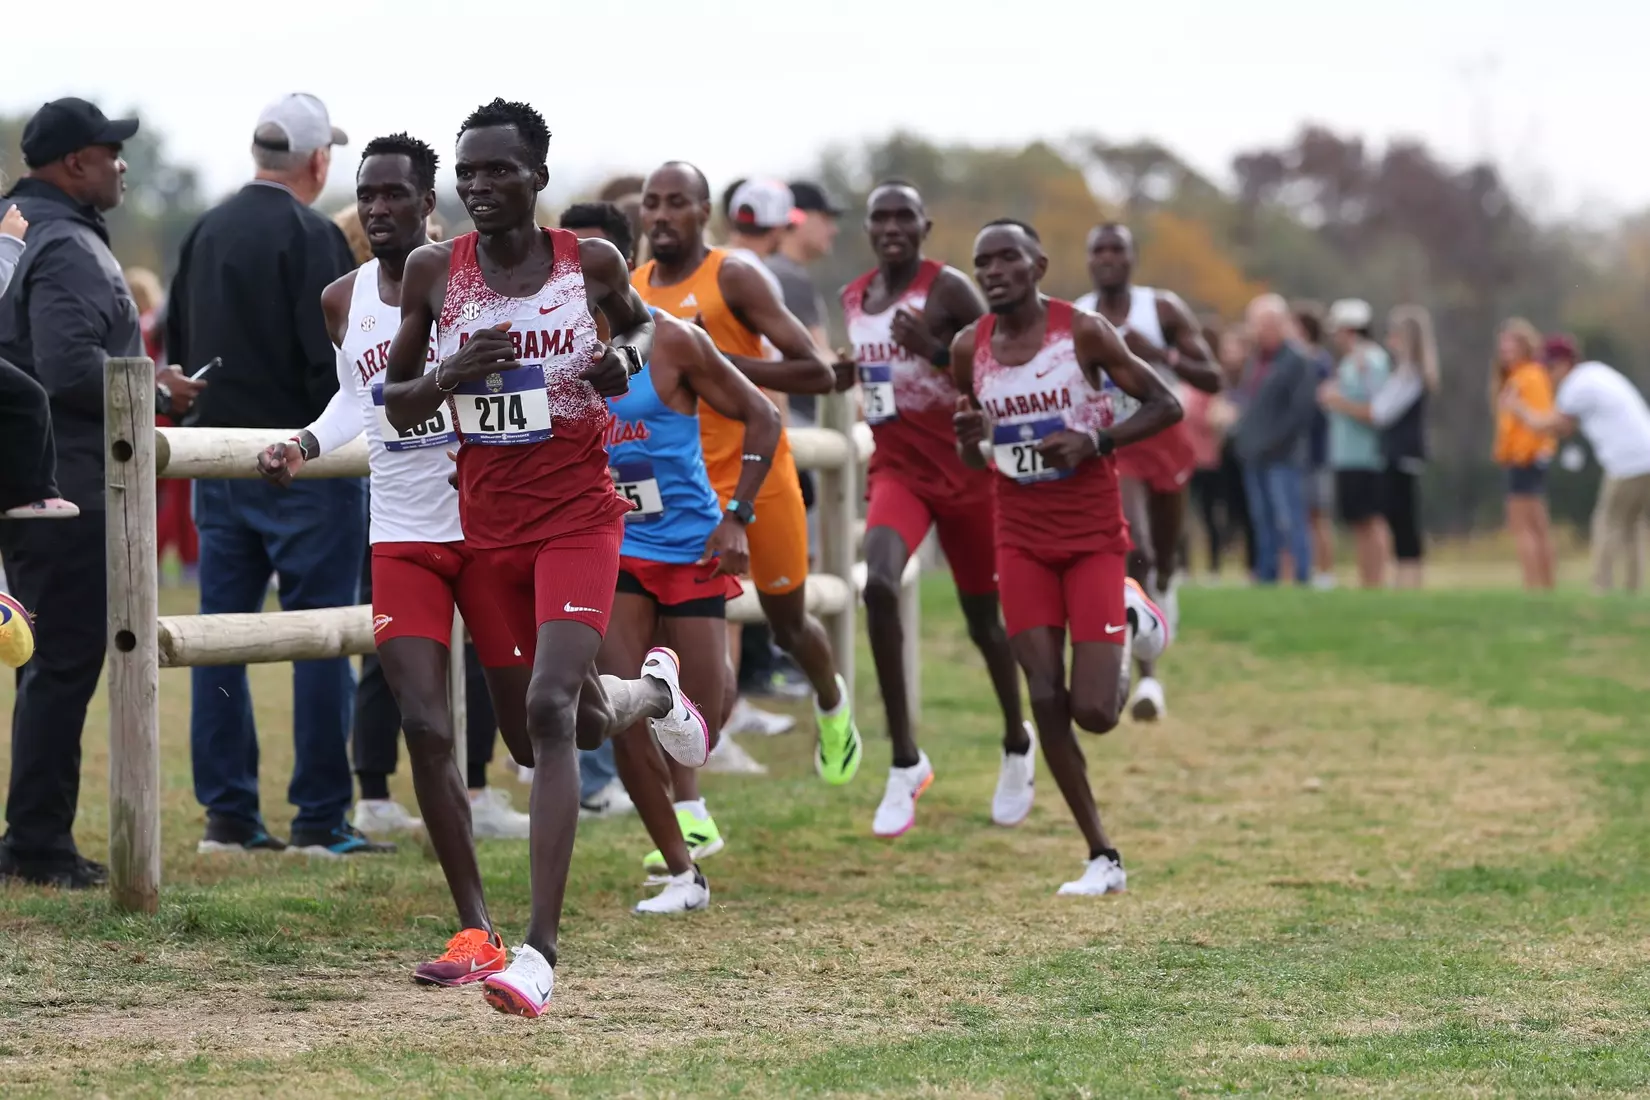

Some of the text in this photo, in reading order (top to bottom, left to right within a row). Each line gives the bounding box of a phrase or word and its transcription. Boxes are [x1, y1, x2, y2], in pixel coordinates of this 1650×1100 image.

[462, 301, 480, 320] SEC
[459, 329, 575, 359] ABAMA
[474, 394, 527, 431] 274
[1012, 444, 1051, 473] 27
